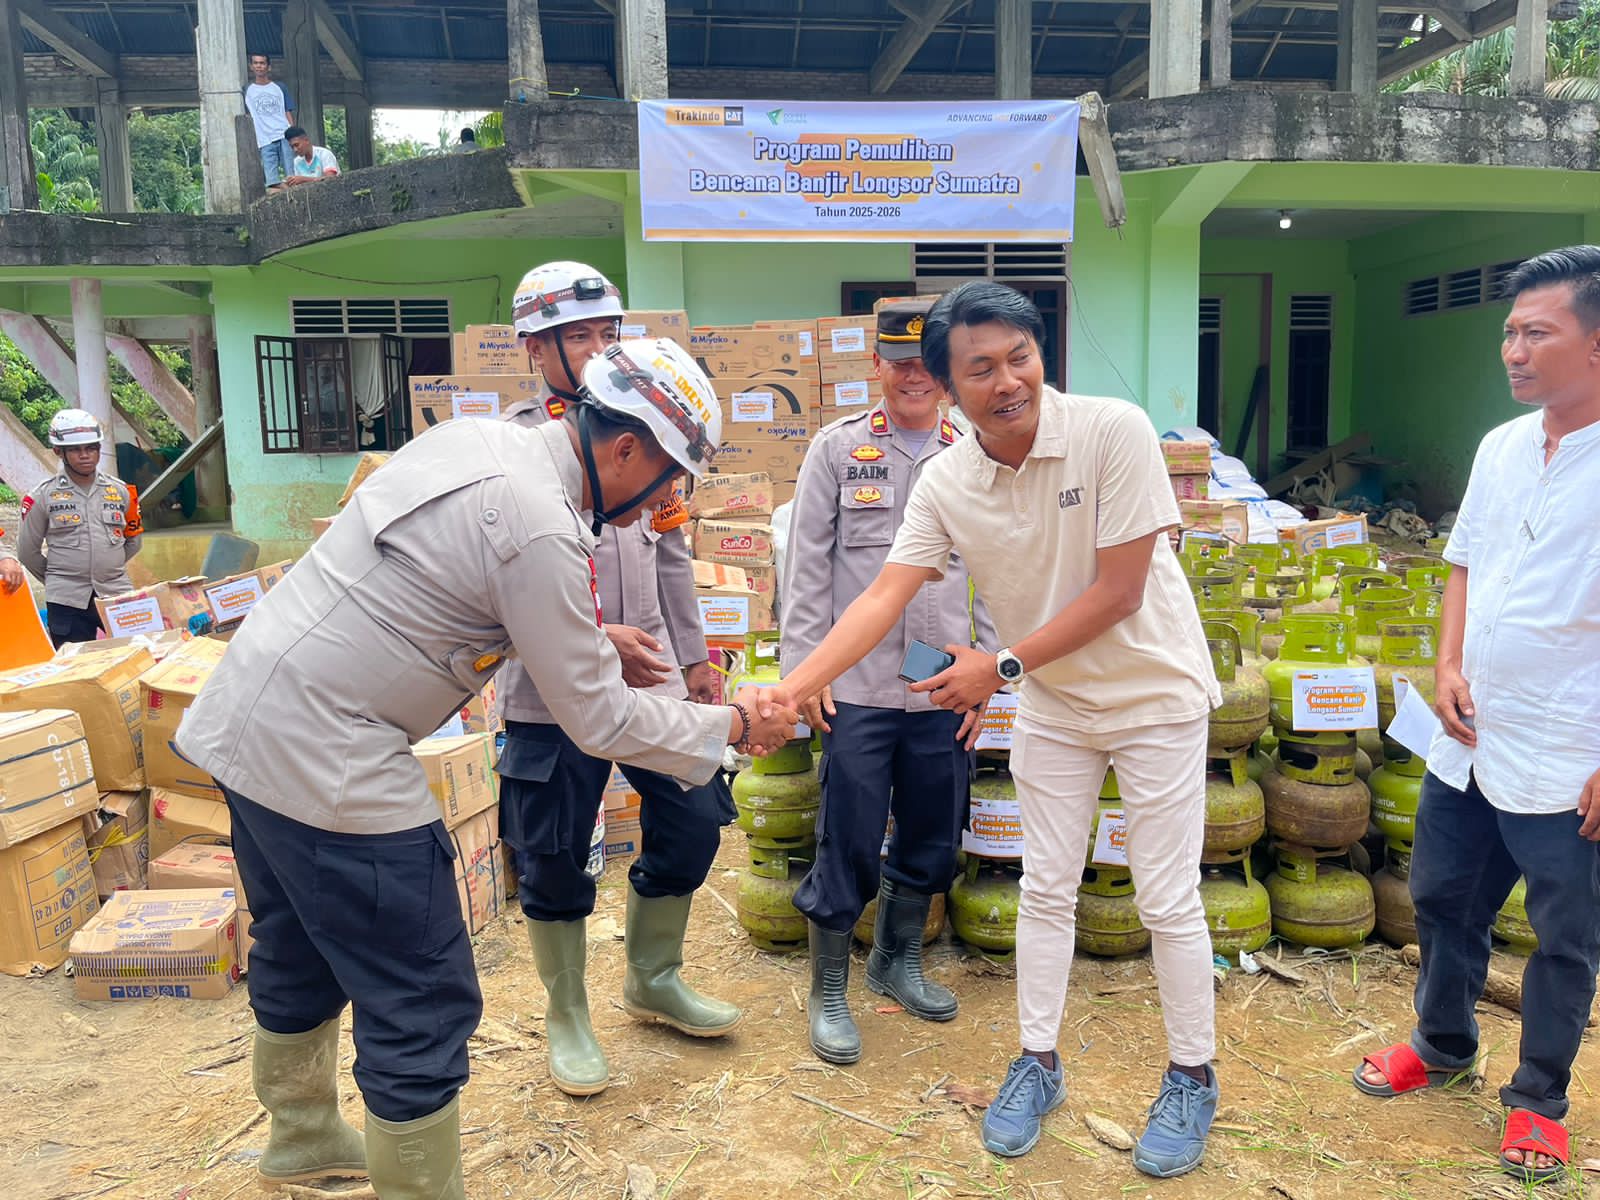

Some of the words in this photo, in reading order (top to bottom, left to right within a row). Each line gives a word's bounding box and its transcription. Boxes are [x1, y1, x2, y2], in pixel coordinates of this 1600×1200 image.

[674, 110, 720, 121] Trakindo
[725, 110, 743, 121] CAT
[946, 113, 993, 122] ADVANCING
[1009, 113, 1048, 122] FORWARD
[753, 137, 842, 165] Program
[845, 138, 953, 161] Pemulihan
[689, 168, 781, 192] Bencana
[785, 170, 849, 198] Banjir
[852, 171, 933, 198] Longsor
[935, 171, 1020, 194] Sumatra
[814, 206, 847, 217] Tahun
[849, 206, 901, 217] 2025-2026
[700, 335, 728, 345] Miyako
[423, 383, 459, 393] Miyako
[767, 426, 798, 437] Miyako
[846, 466, 888, 480] BAIM
[1058, 487, 1082, 509] CAT
[722, 537, 751, 549] SunCo
